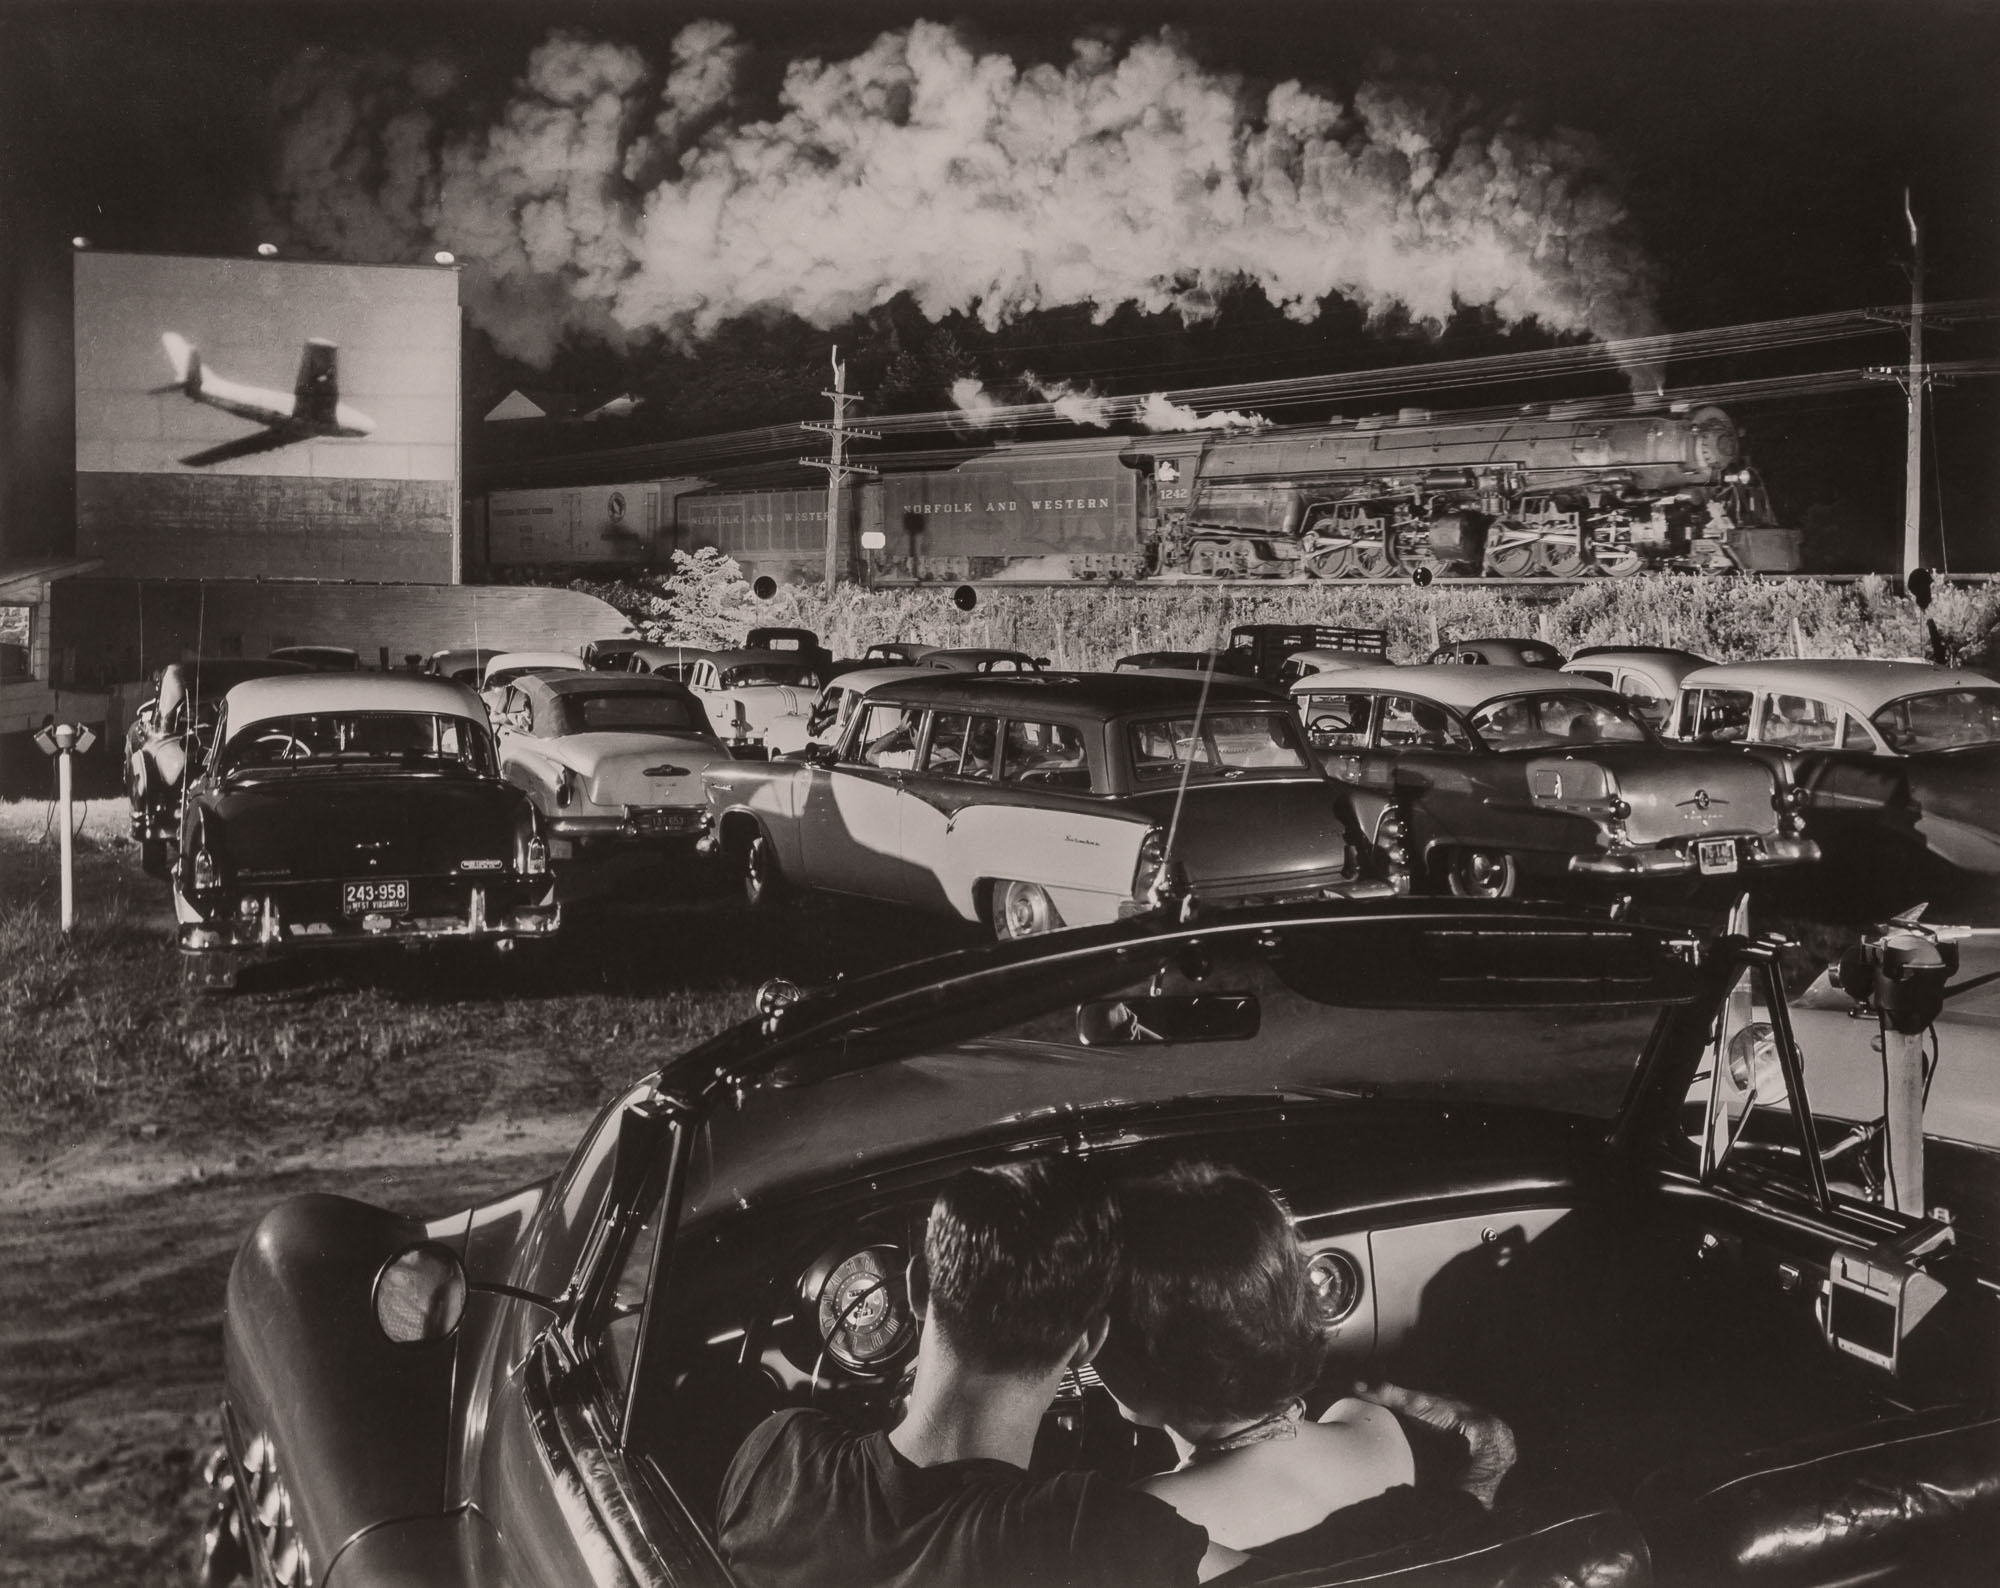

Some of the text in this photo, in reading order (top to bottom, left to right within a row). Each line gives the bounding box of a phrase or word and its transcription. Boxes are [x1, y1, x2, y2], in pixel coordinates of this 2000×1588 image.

[1160, 488, 1188, 500] 1242
[904, 498, 1109, 514] NORFOLK AND WESTERN
[750, 513, 773, 523] AND
[785, 510, 829, 522] WESTER
